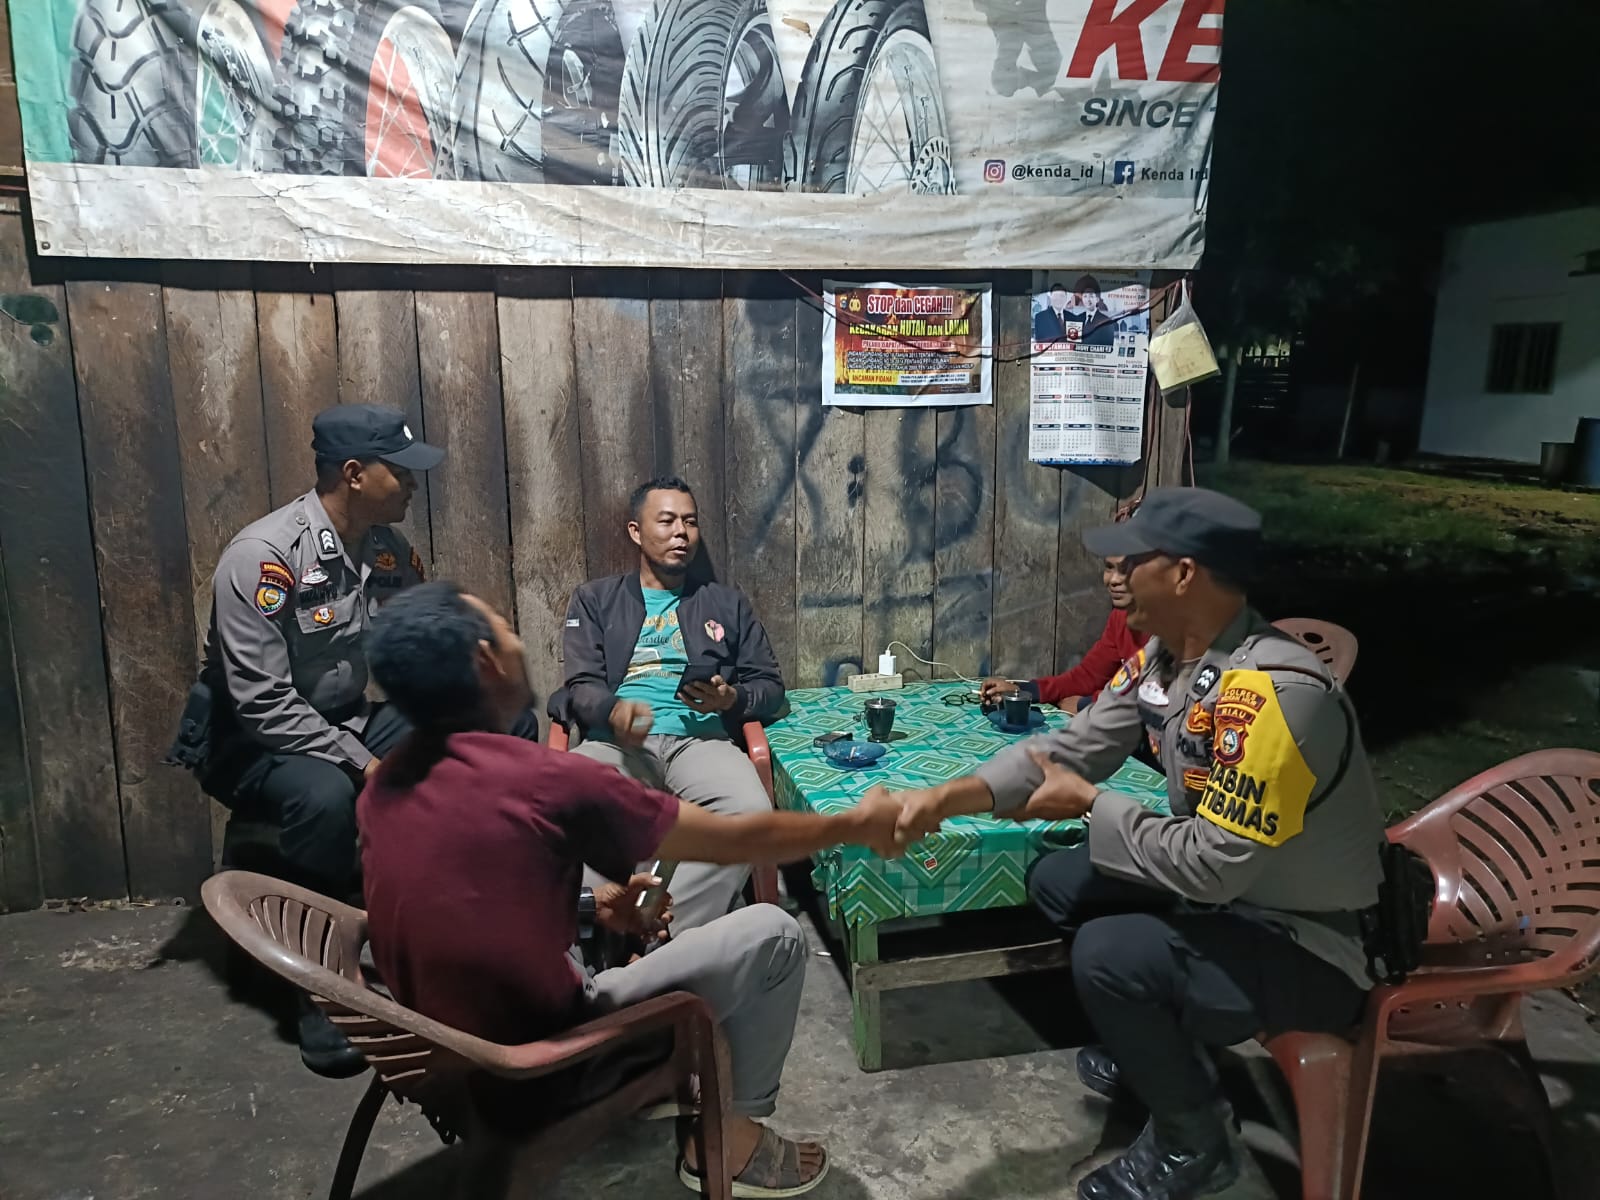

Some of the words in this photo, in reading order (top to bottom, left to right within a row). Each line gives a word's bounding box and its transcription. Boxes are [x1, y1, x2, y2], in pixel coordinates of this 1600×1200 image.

[1080, 97, 1199, 129] SINCE
[1011, 164, 1094, 182] @kenda_id
[1141, 167, 1184, 182] Kenda
[867, 295, 894, 313] STOP
[895, 297, 913, 313] dan
[900, 319, 926, 336] HUTAN
[1224, 688, 1258, 700] POLRES
[1221, 708, 1247, 719] RIAU
